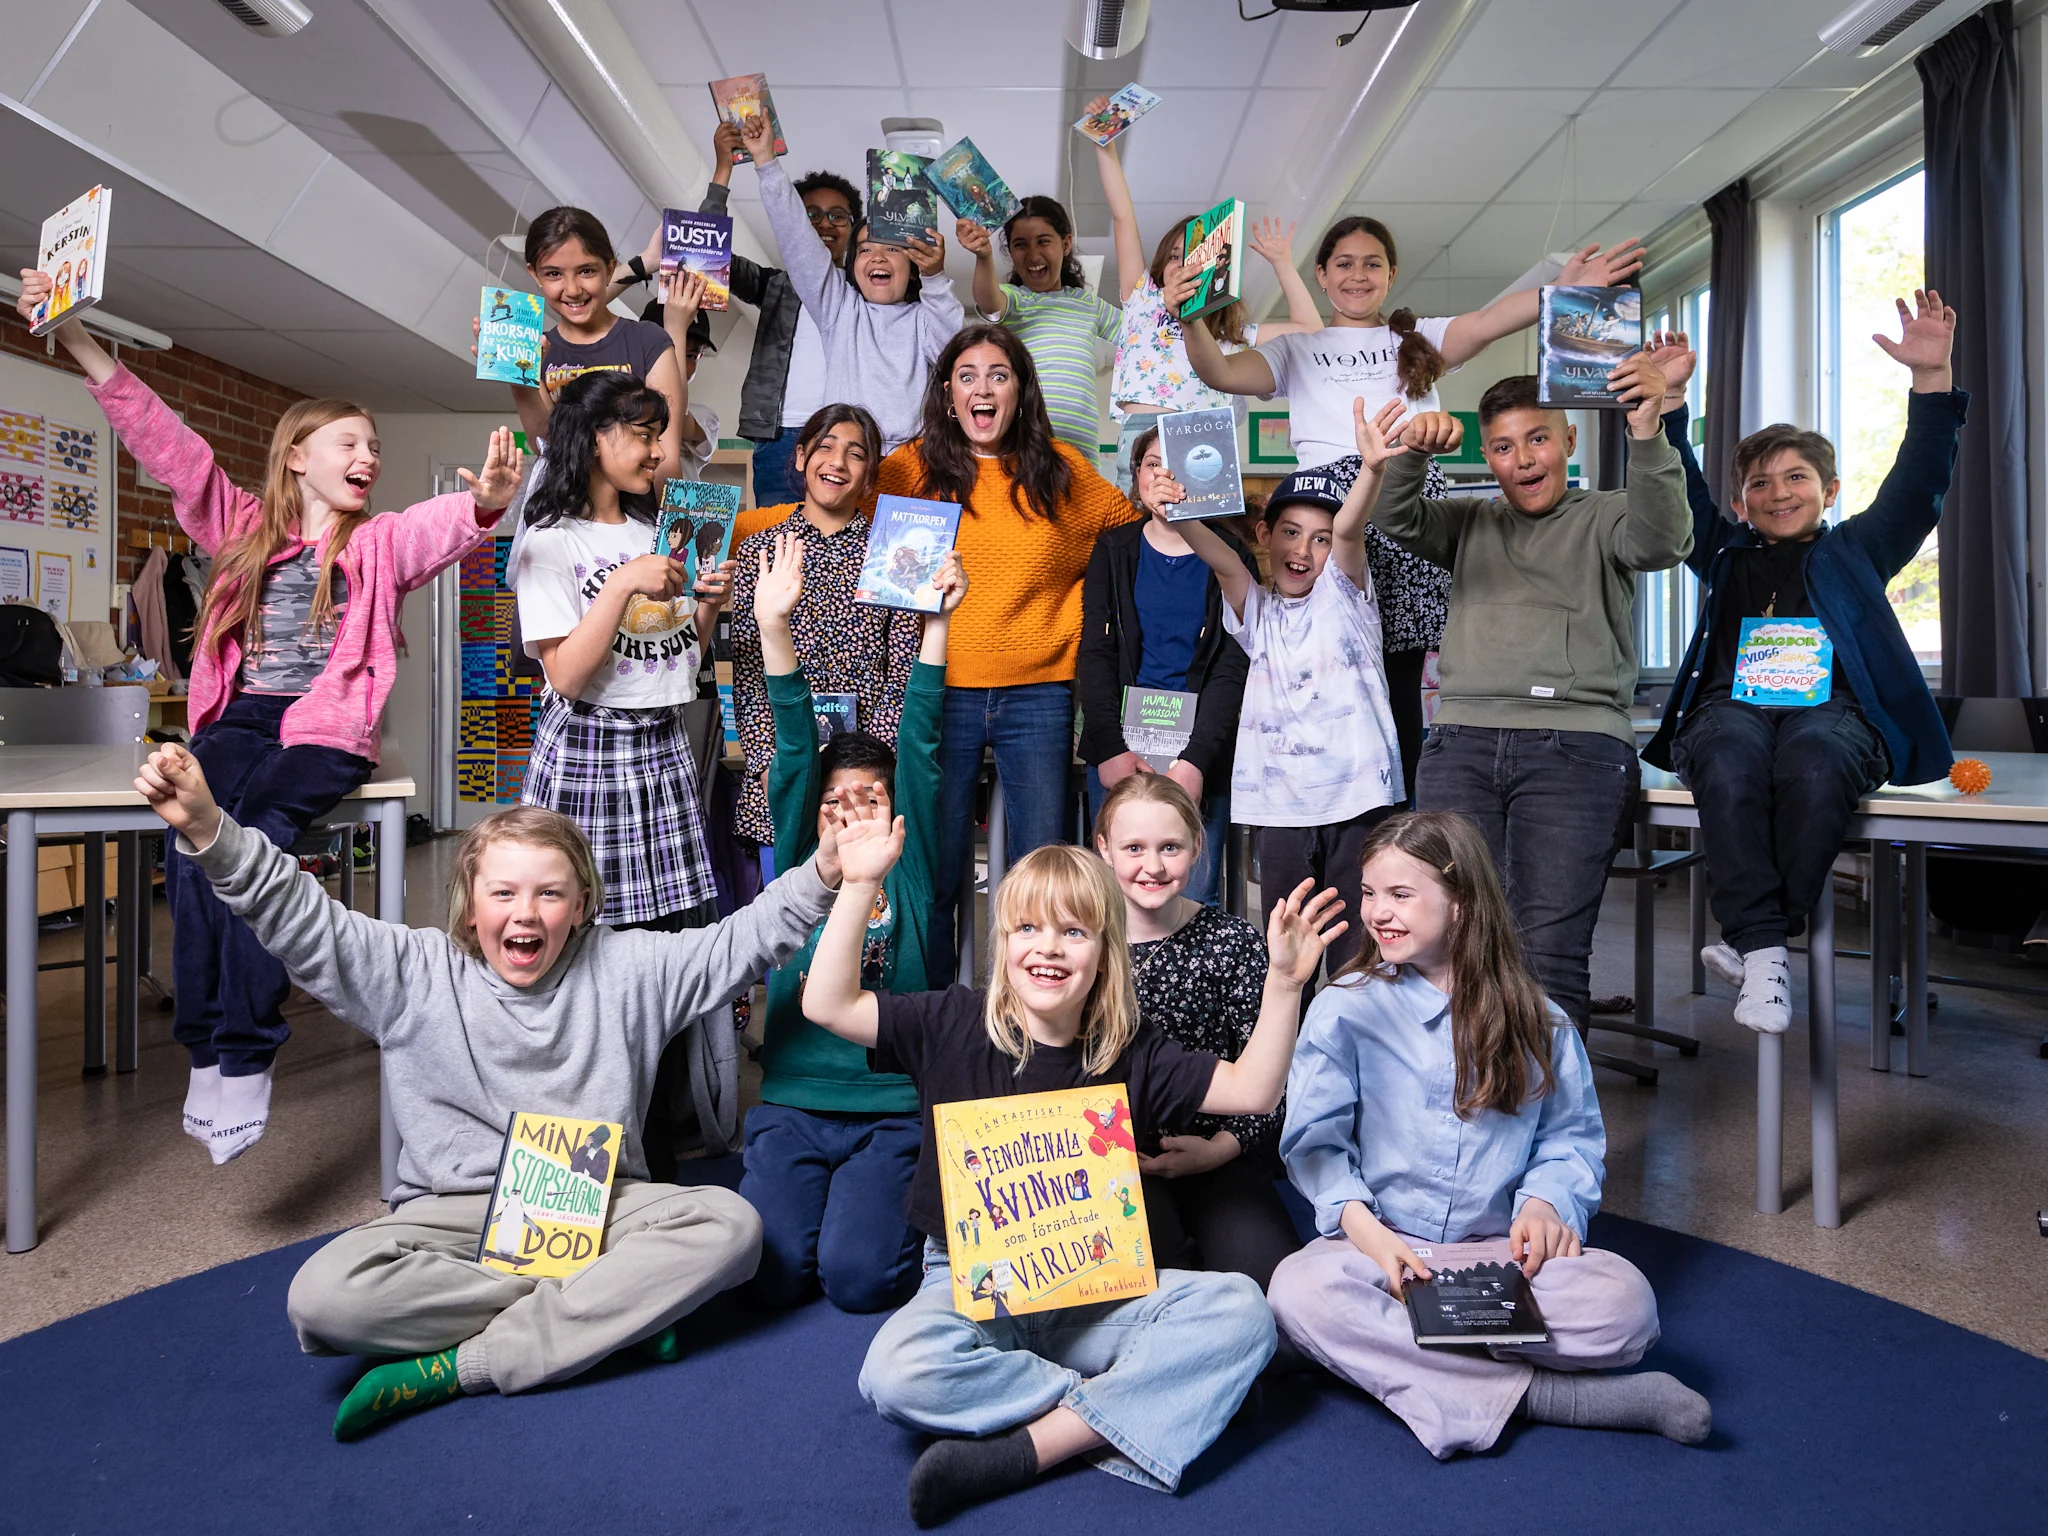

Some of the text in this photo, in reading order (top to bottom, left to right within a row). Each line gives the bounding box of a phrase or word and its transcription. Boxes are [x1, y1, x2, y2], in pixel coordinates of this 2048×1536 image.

[1209, 202, 1232, 234] MITT
[47, 224, 91, 262] KERSTIN
[667, 224, 728, 248] DUSTY
[483, 321, 540, 343] BRORSAN
[496, 344, 537, 363] KUNG!
[1311, 346, 1398, 368] WOME
[1165, 420, 1234, 436] VARGÖGA
[1293, 476, 1328, 492] NEW
[1329, 480, 1347, 503] YOR
[890, 511, 948, 527] NATTKORPEN
[612, 624, 698, 662] THE SUN
[1745, 647, 1780, 664] VLOGG
[1747, 675, 1818, 688] BEROENDE
[813, 702, 849, 713] odite
[1142, 695, 1184, 711] HUMLAN
[183, 1113, 214, 1127] ARTENG
[211, 1120, 262, 1138] ARTENGO
[975, 1106, 1063, 1138] FANTASTISKT
[981, 1128, 1083, 1176] FENOMENALA
[503, 1149, 602, 1217] STORSLAGNA
[975, 1168, 1092, 1231] KVINNOR
[532, 1209, 597, 1225] JENNY JÄGERFELD
[1004, 1209, 1100, 1248] som förändrade
[523, 1226, 593, 1261] DÖD
[1010, 1226, 1115, 1292] VÄRLDEN
[1103, 1275, 1147, 1293] Pankhurst
